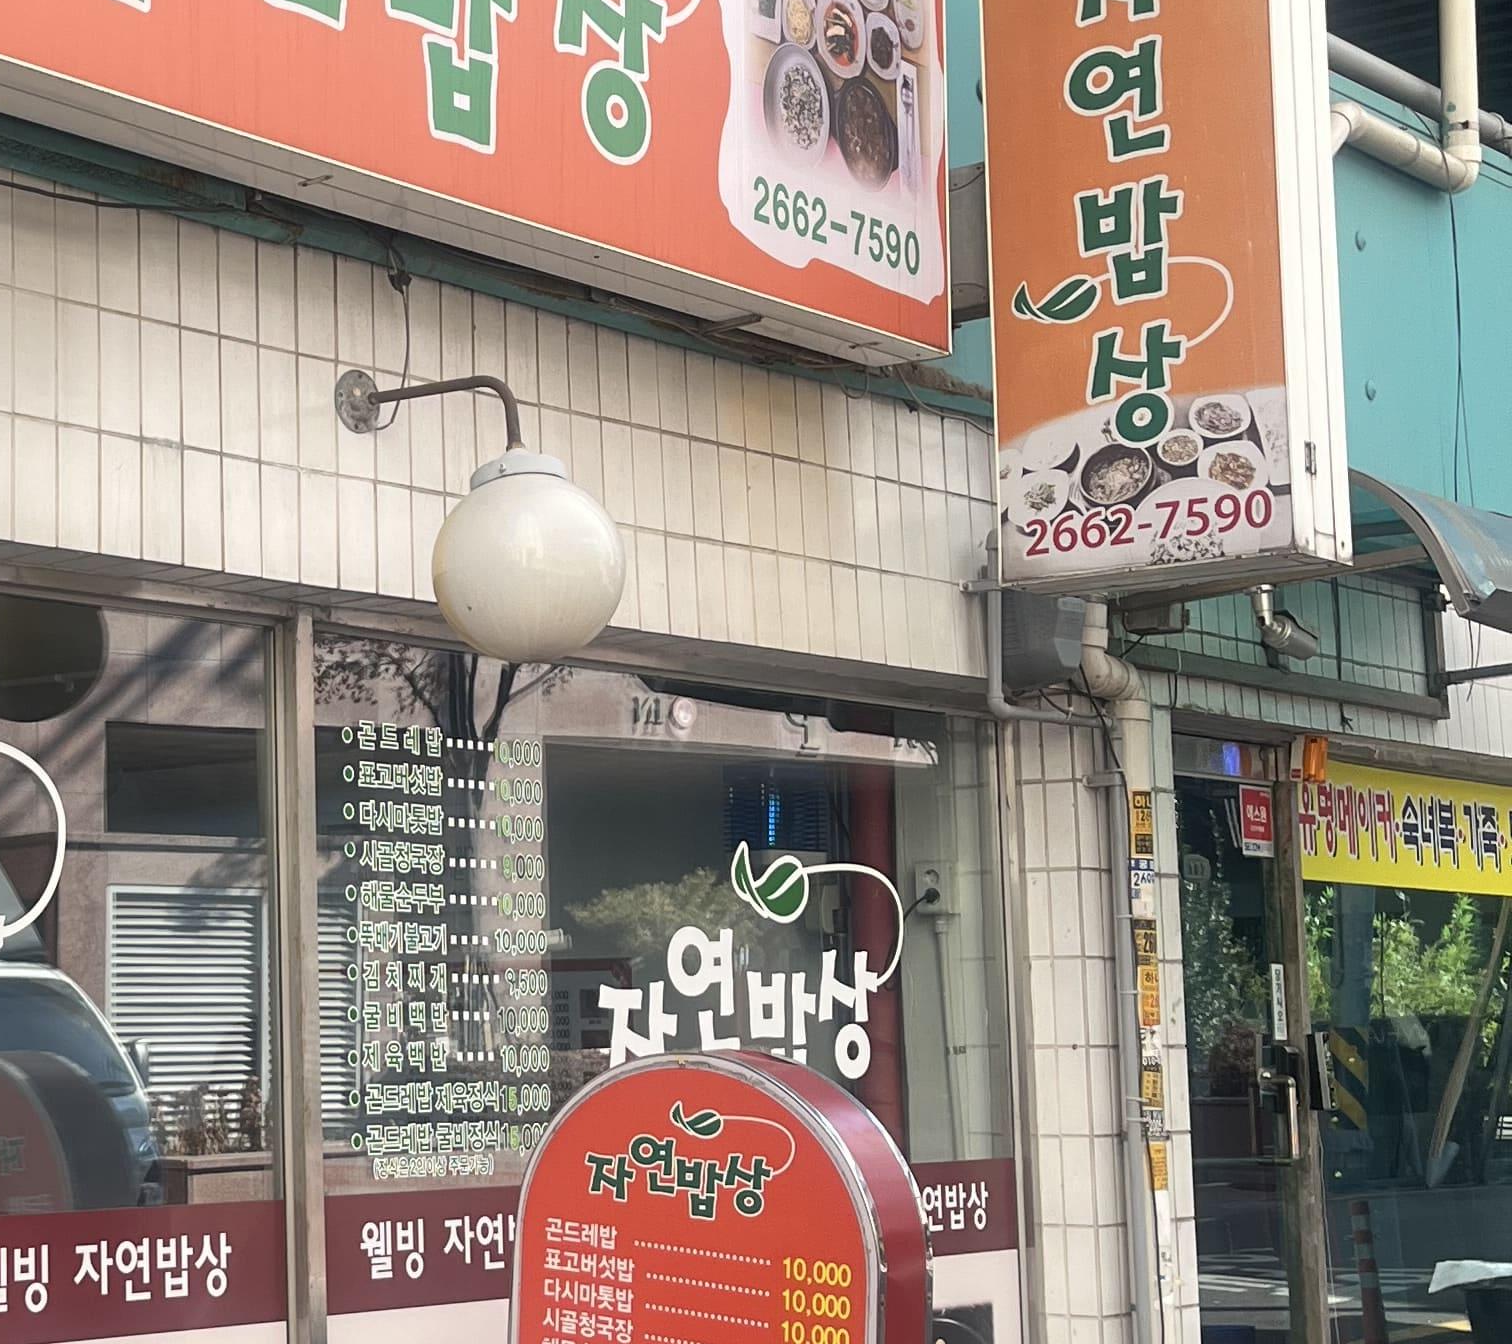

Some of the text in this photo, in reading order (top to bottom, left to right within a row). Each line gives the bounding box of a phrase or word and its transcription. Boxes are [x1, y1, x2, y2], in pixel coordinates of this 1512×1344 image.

[752, 174, 922, 278] 2662-7590
[1023, 488, 1274, 558] 2662-7590
[358, 720, 443, 757] 곤드레밥
[358, 761, 443, 796] 표고버섯밥
[359, 800, 544, 844] 다시마톳밥 10,000
[360, 840, 545, 883] 시골청국장 9,000
[361, 880, 546, 921] 해물순두부 10,000
[360, 921, 548, 955] 뚝배기불고기 10,000
[362, 960, 548, 1000] 김치찌개 9,500
[363, 1001, 549, 1036] 굴비백반 10,000
[599, 926, 879, 1079] 자연밥상
[362, 1040, 550, 1077] 제육백반 10,000
[365, 1081, 551, 1116] 곤드레밥 제육정식 15,000
[365, 1123, 433, 1155] 곤드레밥
[436, 1120, 501, 1152] 굴비정식
[585, 1134, 773, 1220] 자연밥상
[919, 1181, 990, 1233] 연밥상
[73, 1232, 233, 1303] 자연밥상
[360, 1213, 516, 1280] 웰빙 자연
[544, 1217, 852, 1289] 곤드레밥 10,000
[543, 1277, 634, 1314] 다시마톳밥
[544, 1247, 851, 1321] 표고버섯밥 10,000
[542, 1308, 634, 1344] 시골청국장
